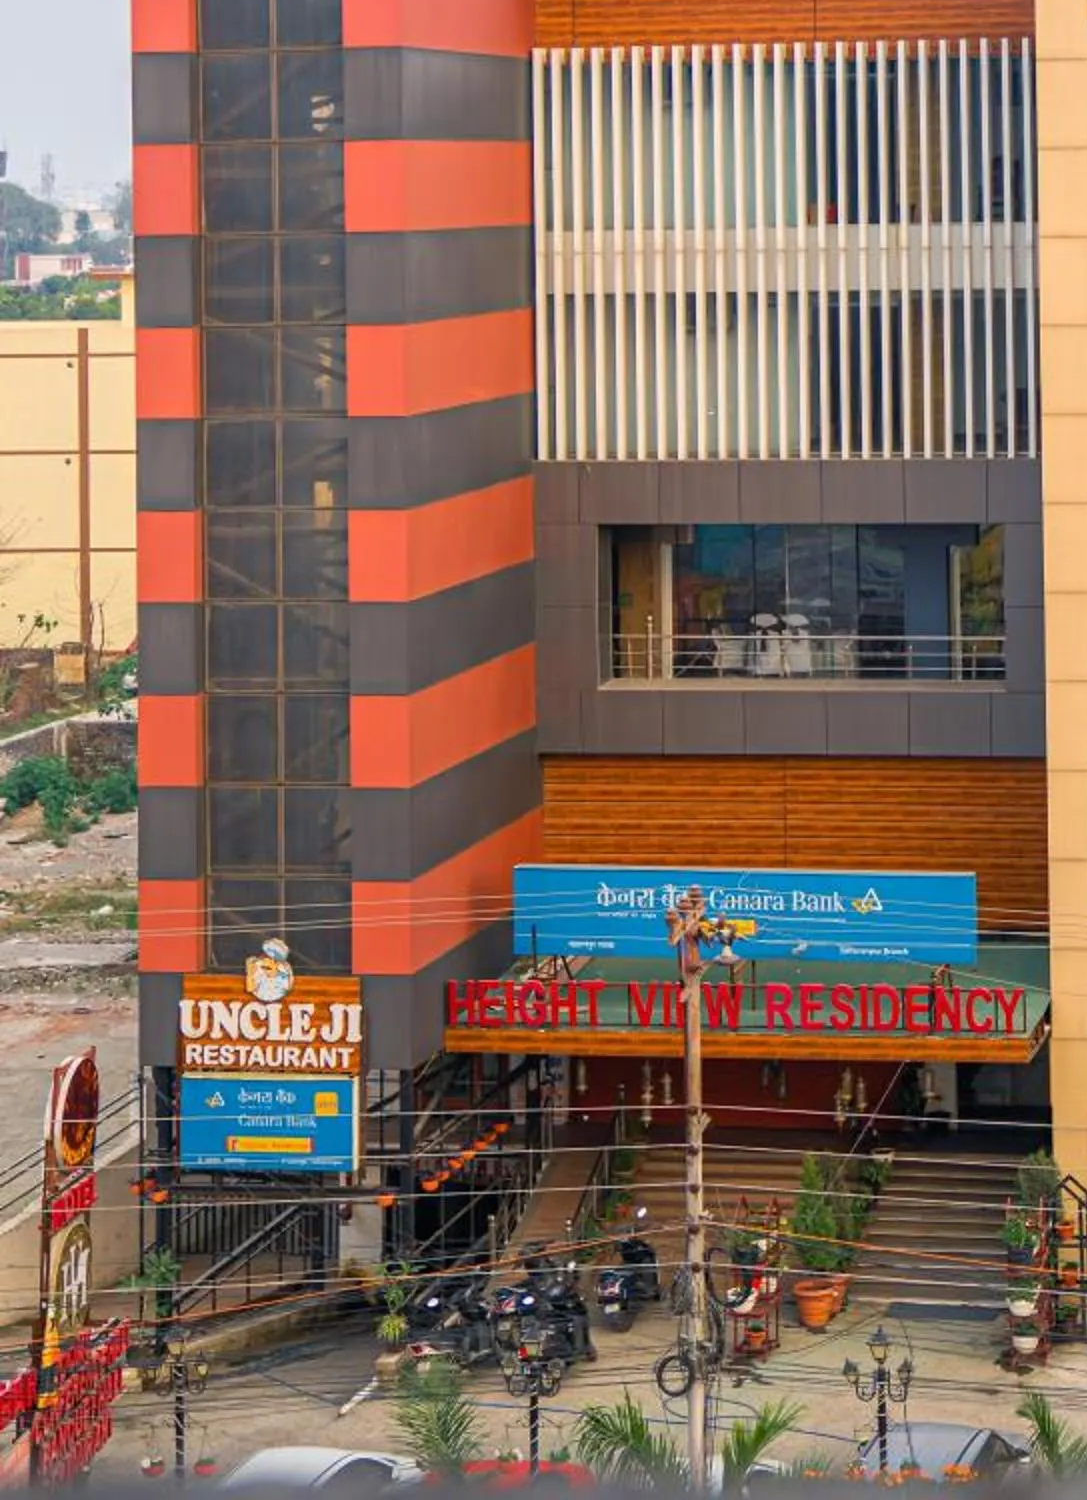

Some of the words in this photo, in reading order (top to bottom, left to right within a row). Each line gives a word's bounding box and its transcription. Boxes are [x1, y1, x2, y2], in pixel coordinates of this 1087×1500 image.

[708, 887, 785, 911] Canara
[791, 890, 846, 913] Bank
[179, 999, 317, 1043] UNCLE
[320, 1002, 363, 1043] JI
[447, 978, 607, 1030] HEIGHT
[764, 982, 1025, 1034] RESIDENCY
[184, 1043, 355, 1069] RESTAURANT
